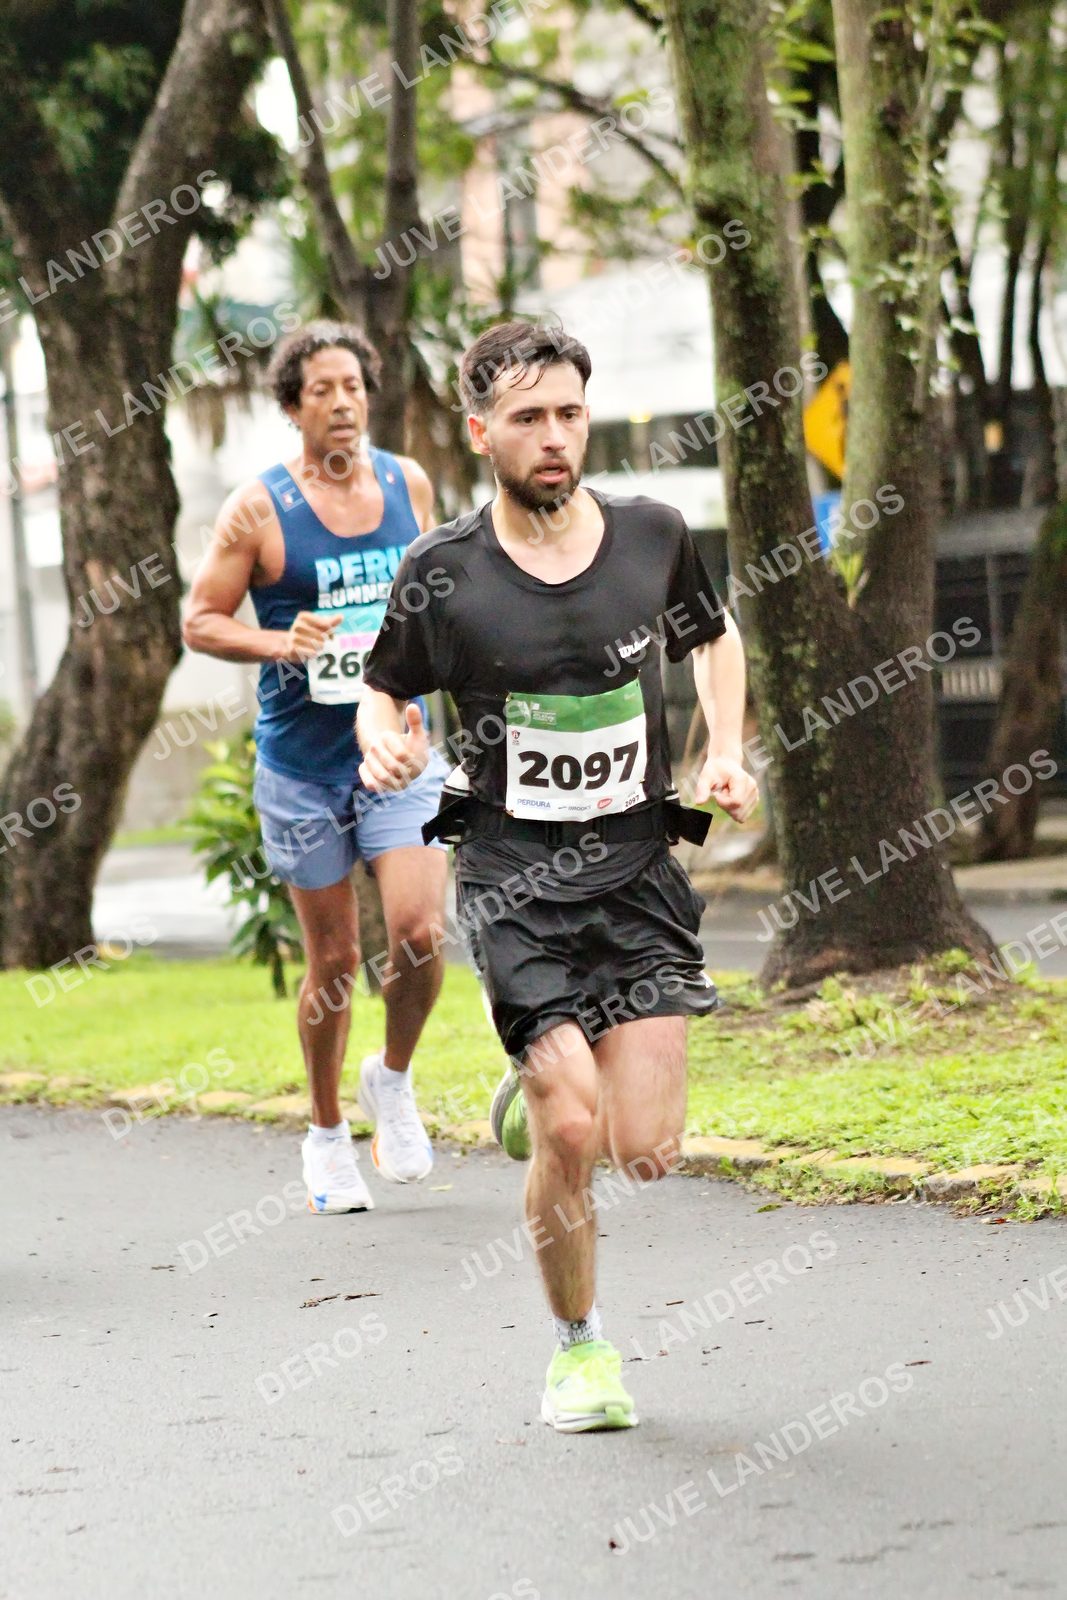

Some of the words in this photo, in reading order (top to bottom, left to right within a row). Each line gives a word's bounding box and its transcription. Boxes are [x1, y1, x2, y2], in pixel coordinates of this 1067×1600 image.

[315, 546, 406, 593] PERU
[318, 582, 393, 608] RUNNE
[517, 740, 639, 791] 2097
[517, 798, 551, 809] PERDURA
[625, 794, 640, 807] 2097
